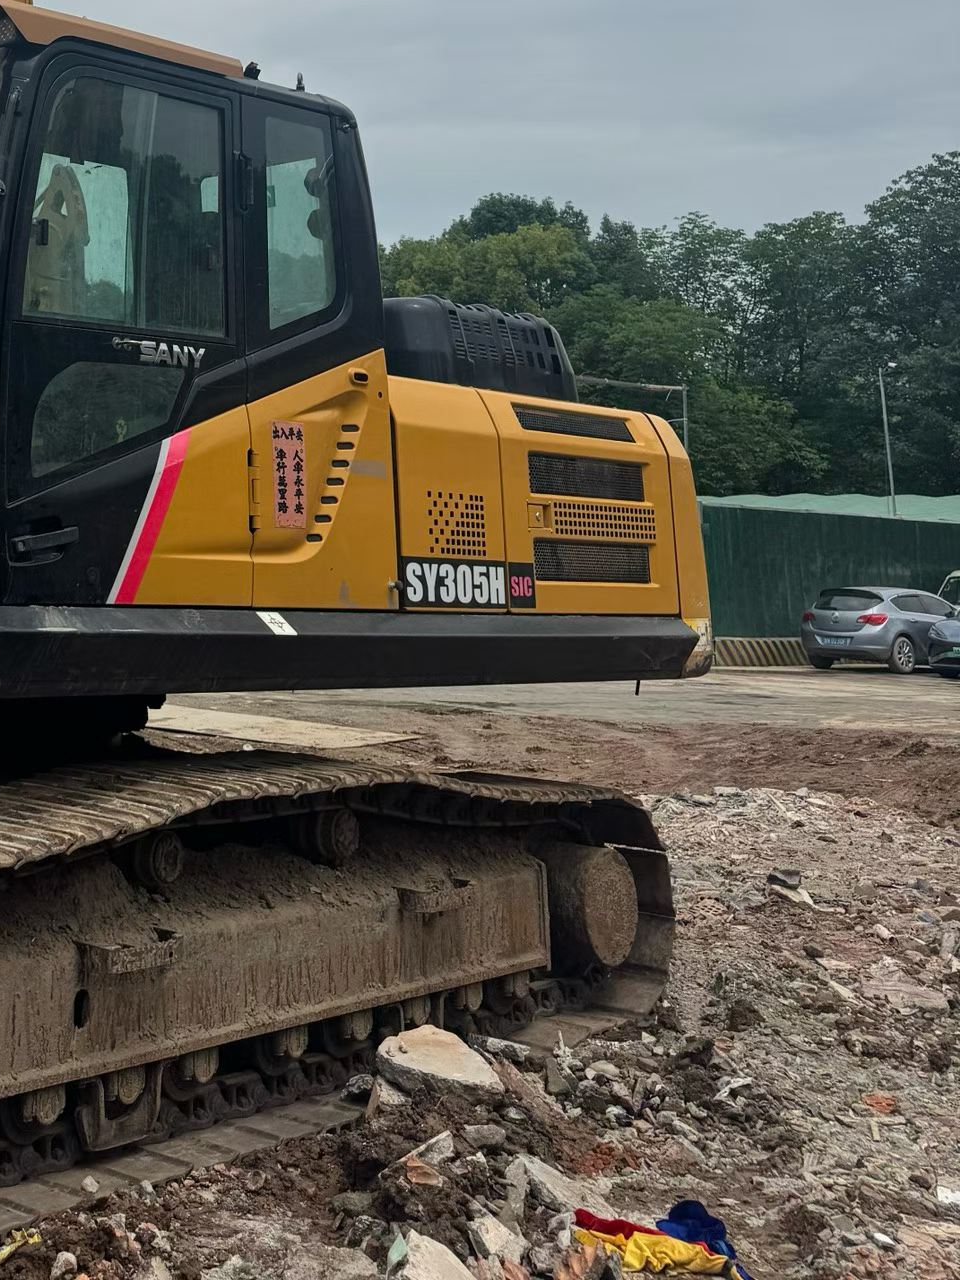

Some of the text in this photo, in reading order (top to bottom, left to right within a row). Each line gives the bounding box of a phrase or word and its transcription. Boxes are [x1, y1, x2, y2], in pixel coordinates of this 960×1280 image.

[139, 340, 206, 369] SANY
[406, 562, 533, 605] SY305H SIC
